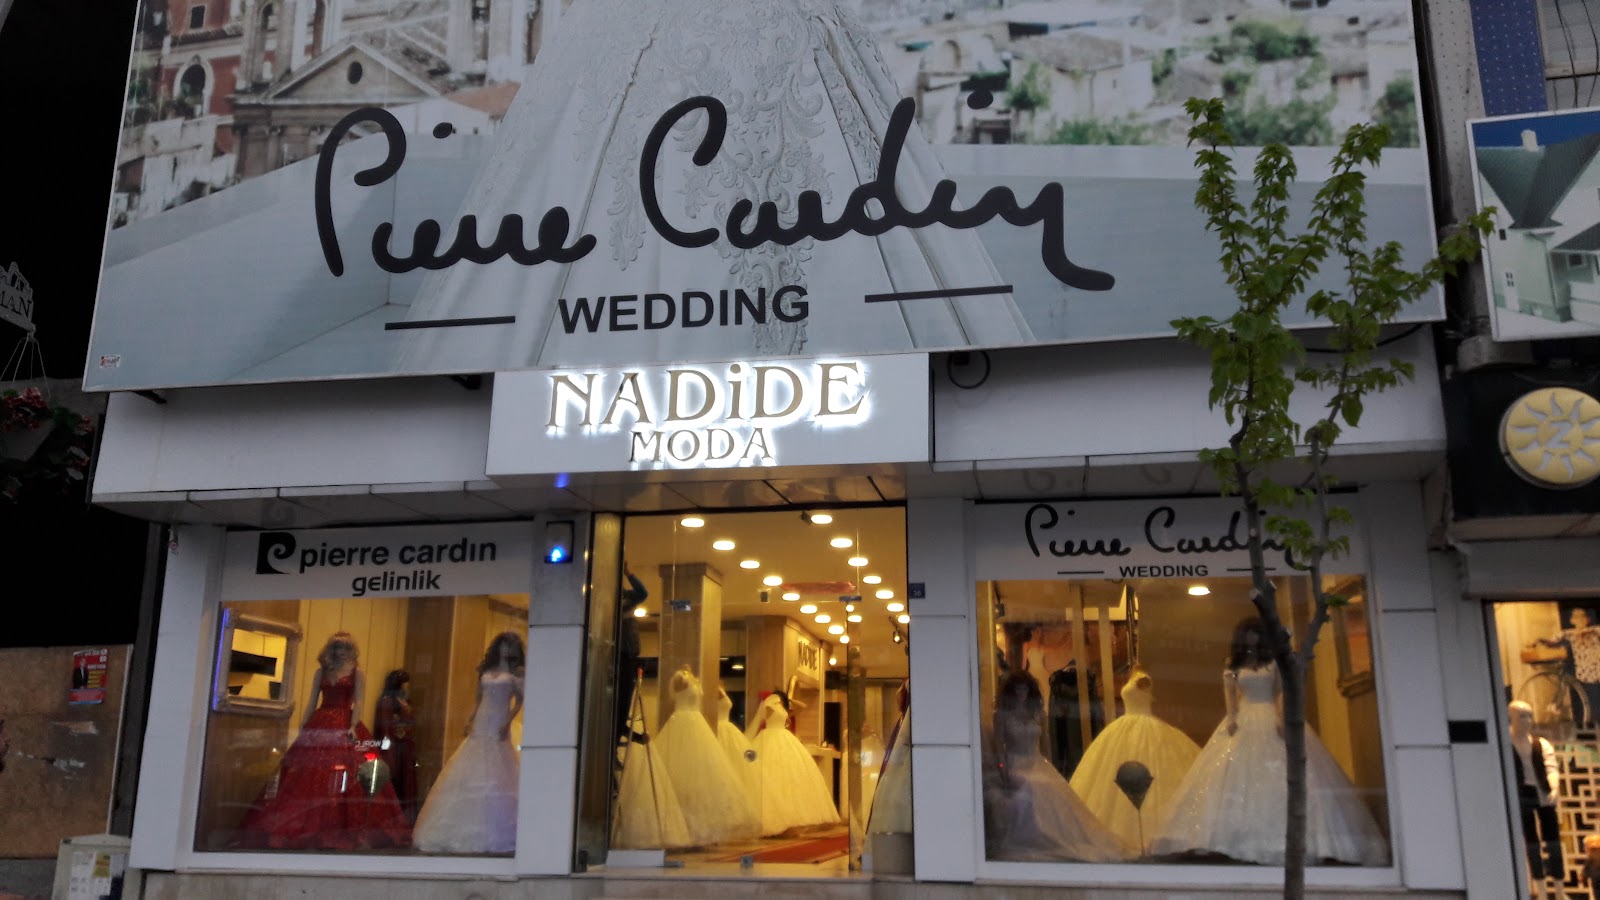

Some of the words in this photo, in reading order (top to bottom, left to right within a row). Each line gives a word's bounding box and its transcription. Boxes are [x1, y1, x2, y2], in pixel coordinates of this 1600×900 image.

[315, 104, 597, 277] Pierre
[640, 88, 1116, 291] Cardin
[557, 285, 809, 334] WEDDING
[630, 427, 774, 464] MODA
[1025, 503, 1132, 558] Pierre
[299, 541, 390, 574] pierre
[1119, 564, 1209, 578] WEDDING
[351, 570, 442, 597] gelinlik
